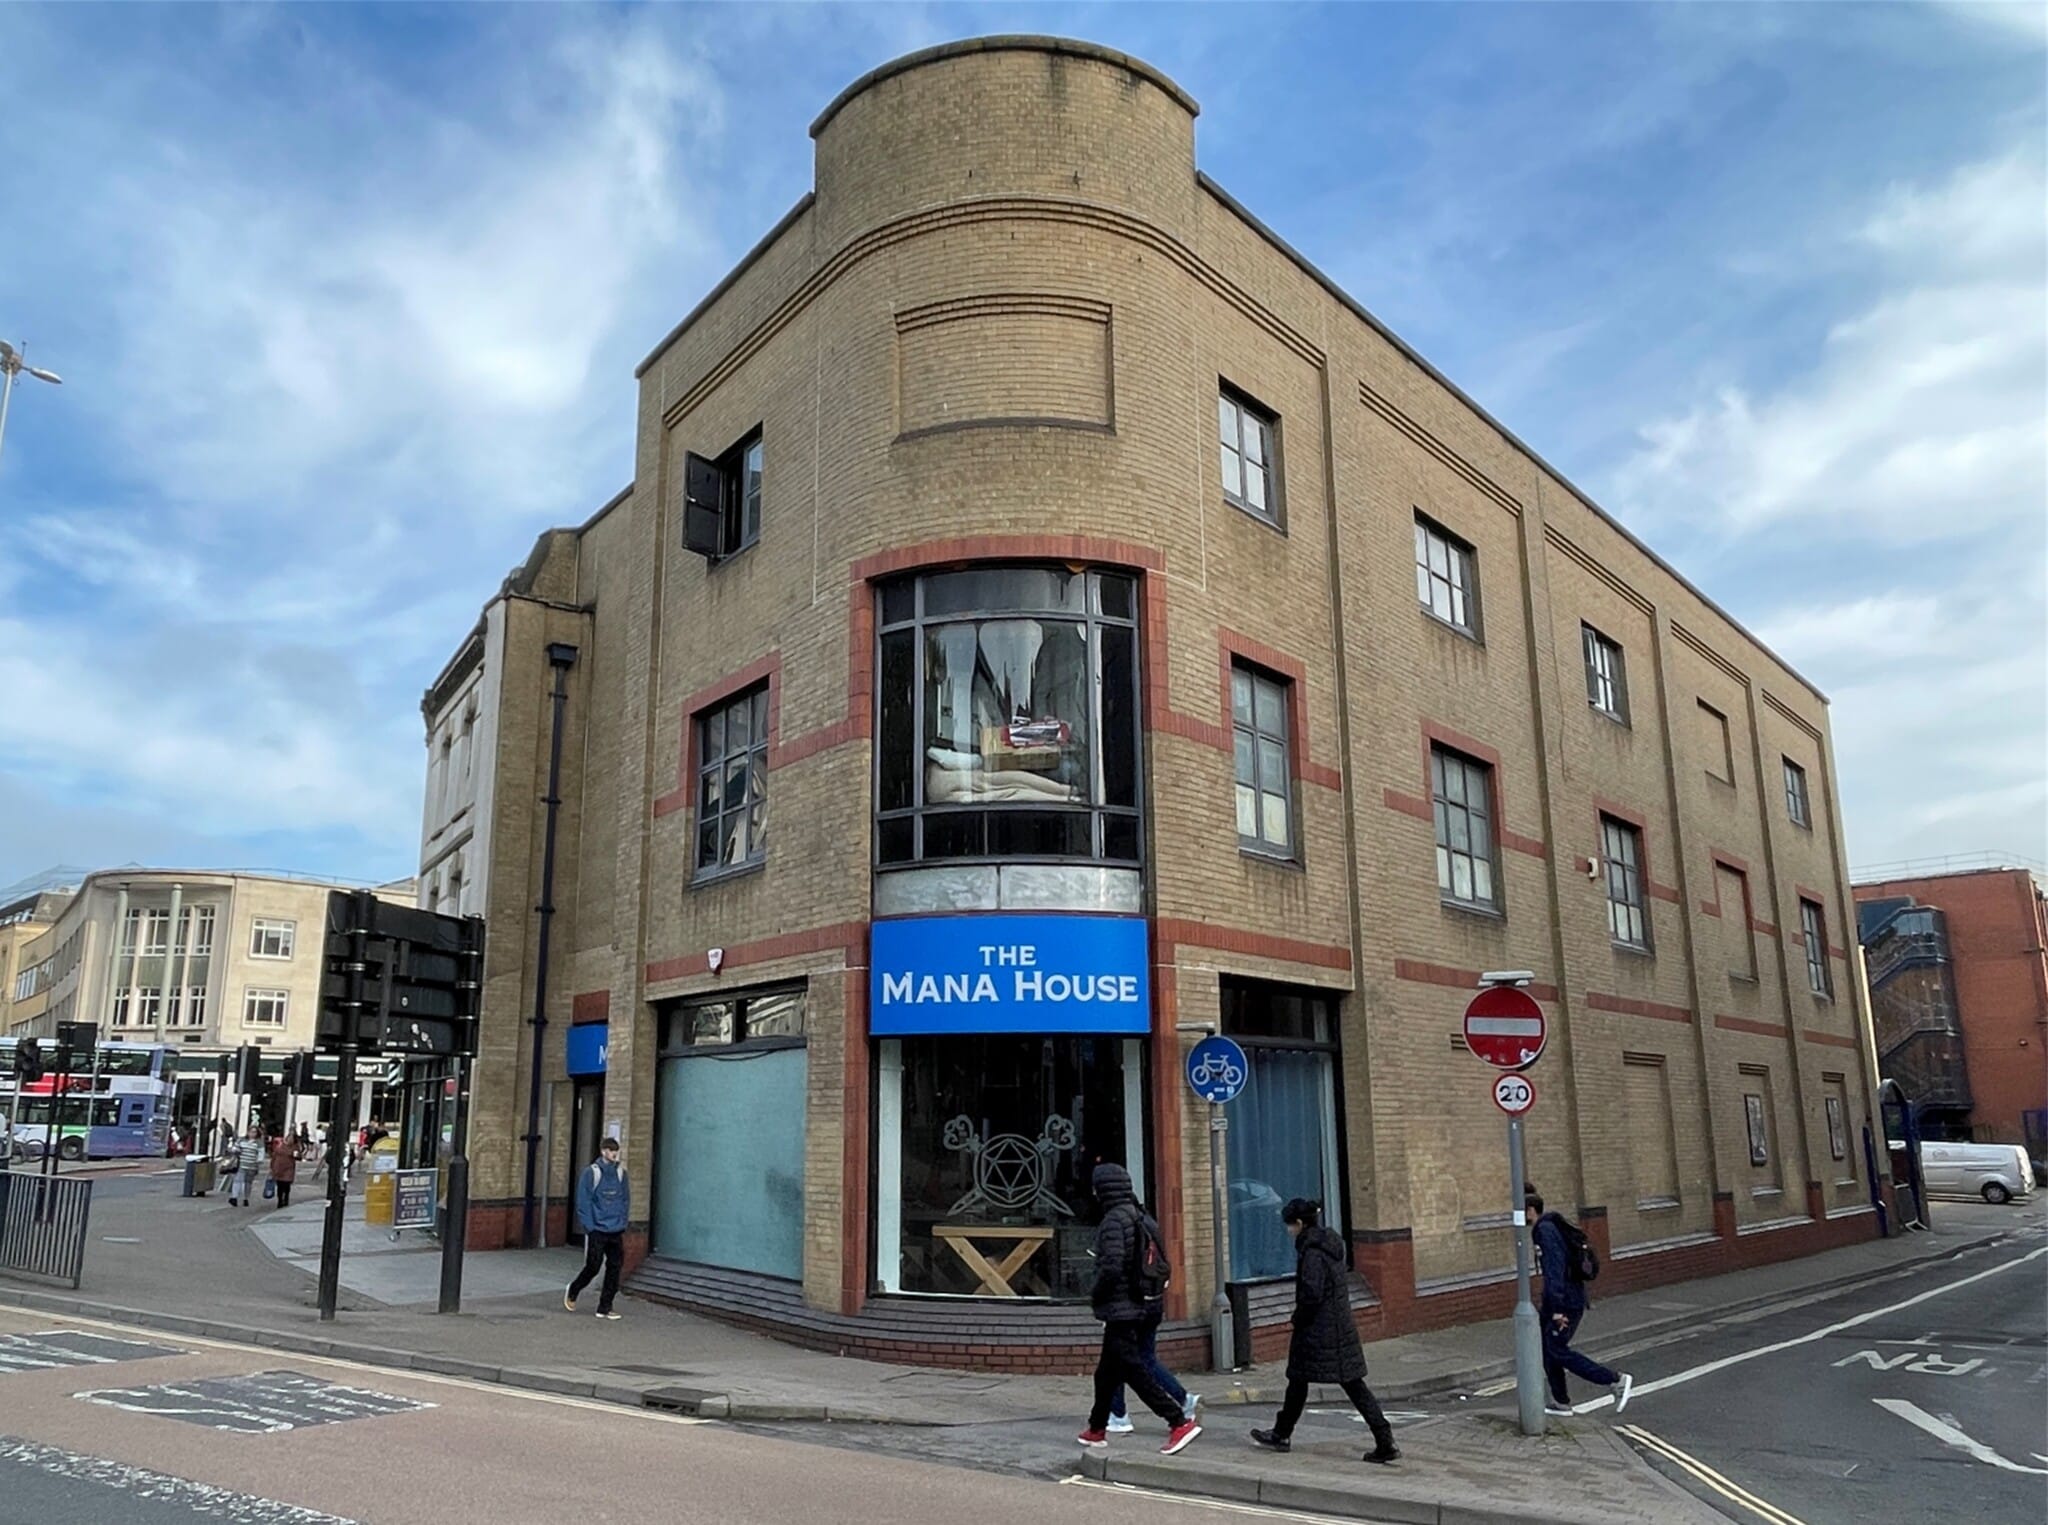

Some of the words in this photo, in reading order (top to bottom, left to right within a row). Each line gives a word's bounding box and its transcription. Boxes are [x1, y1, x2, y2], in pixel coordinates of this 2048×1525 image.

[979, 945, 1036, 966] THE
[882, 971, 1000, 1004] MANA
[1015, 970, 1139, 1003] HOUSE
[1499, 1085, 1530, 1102] 20
